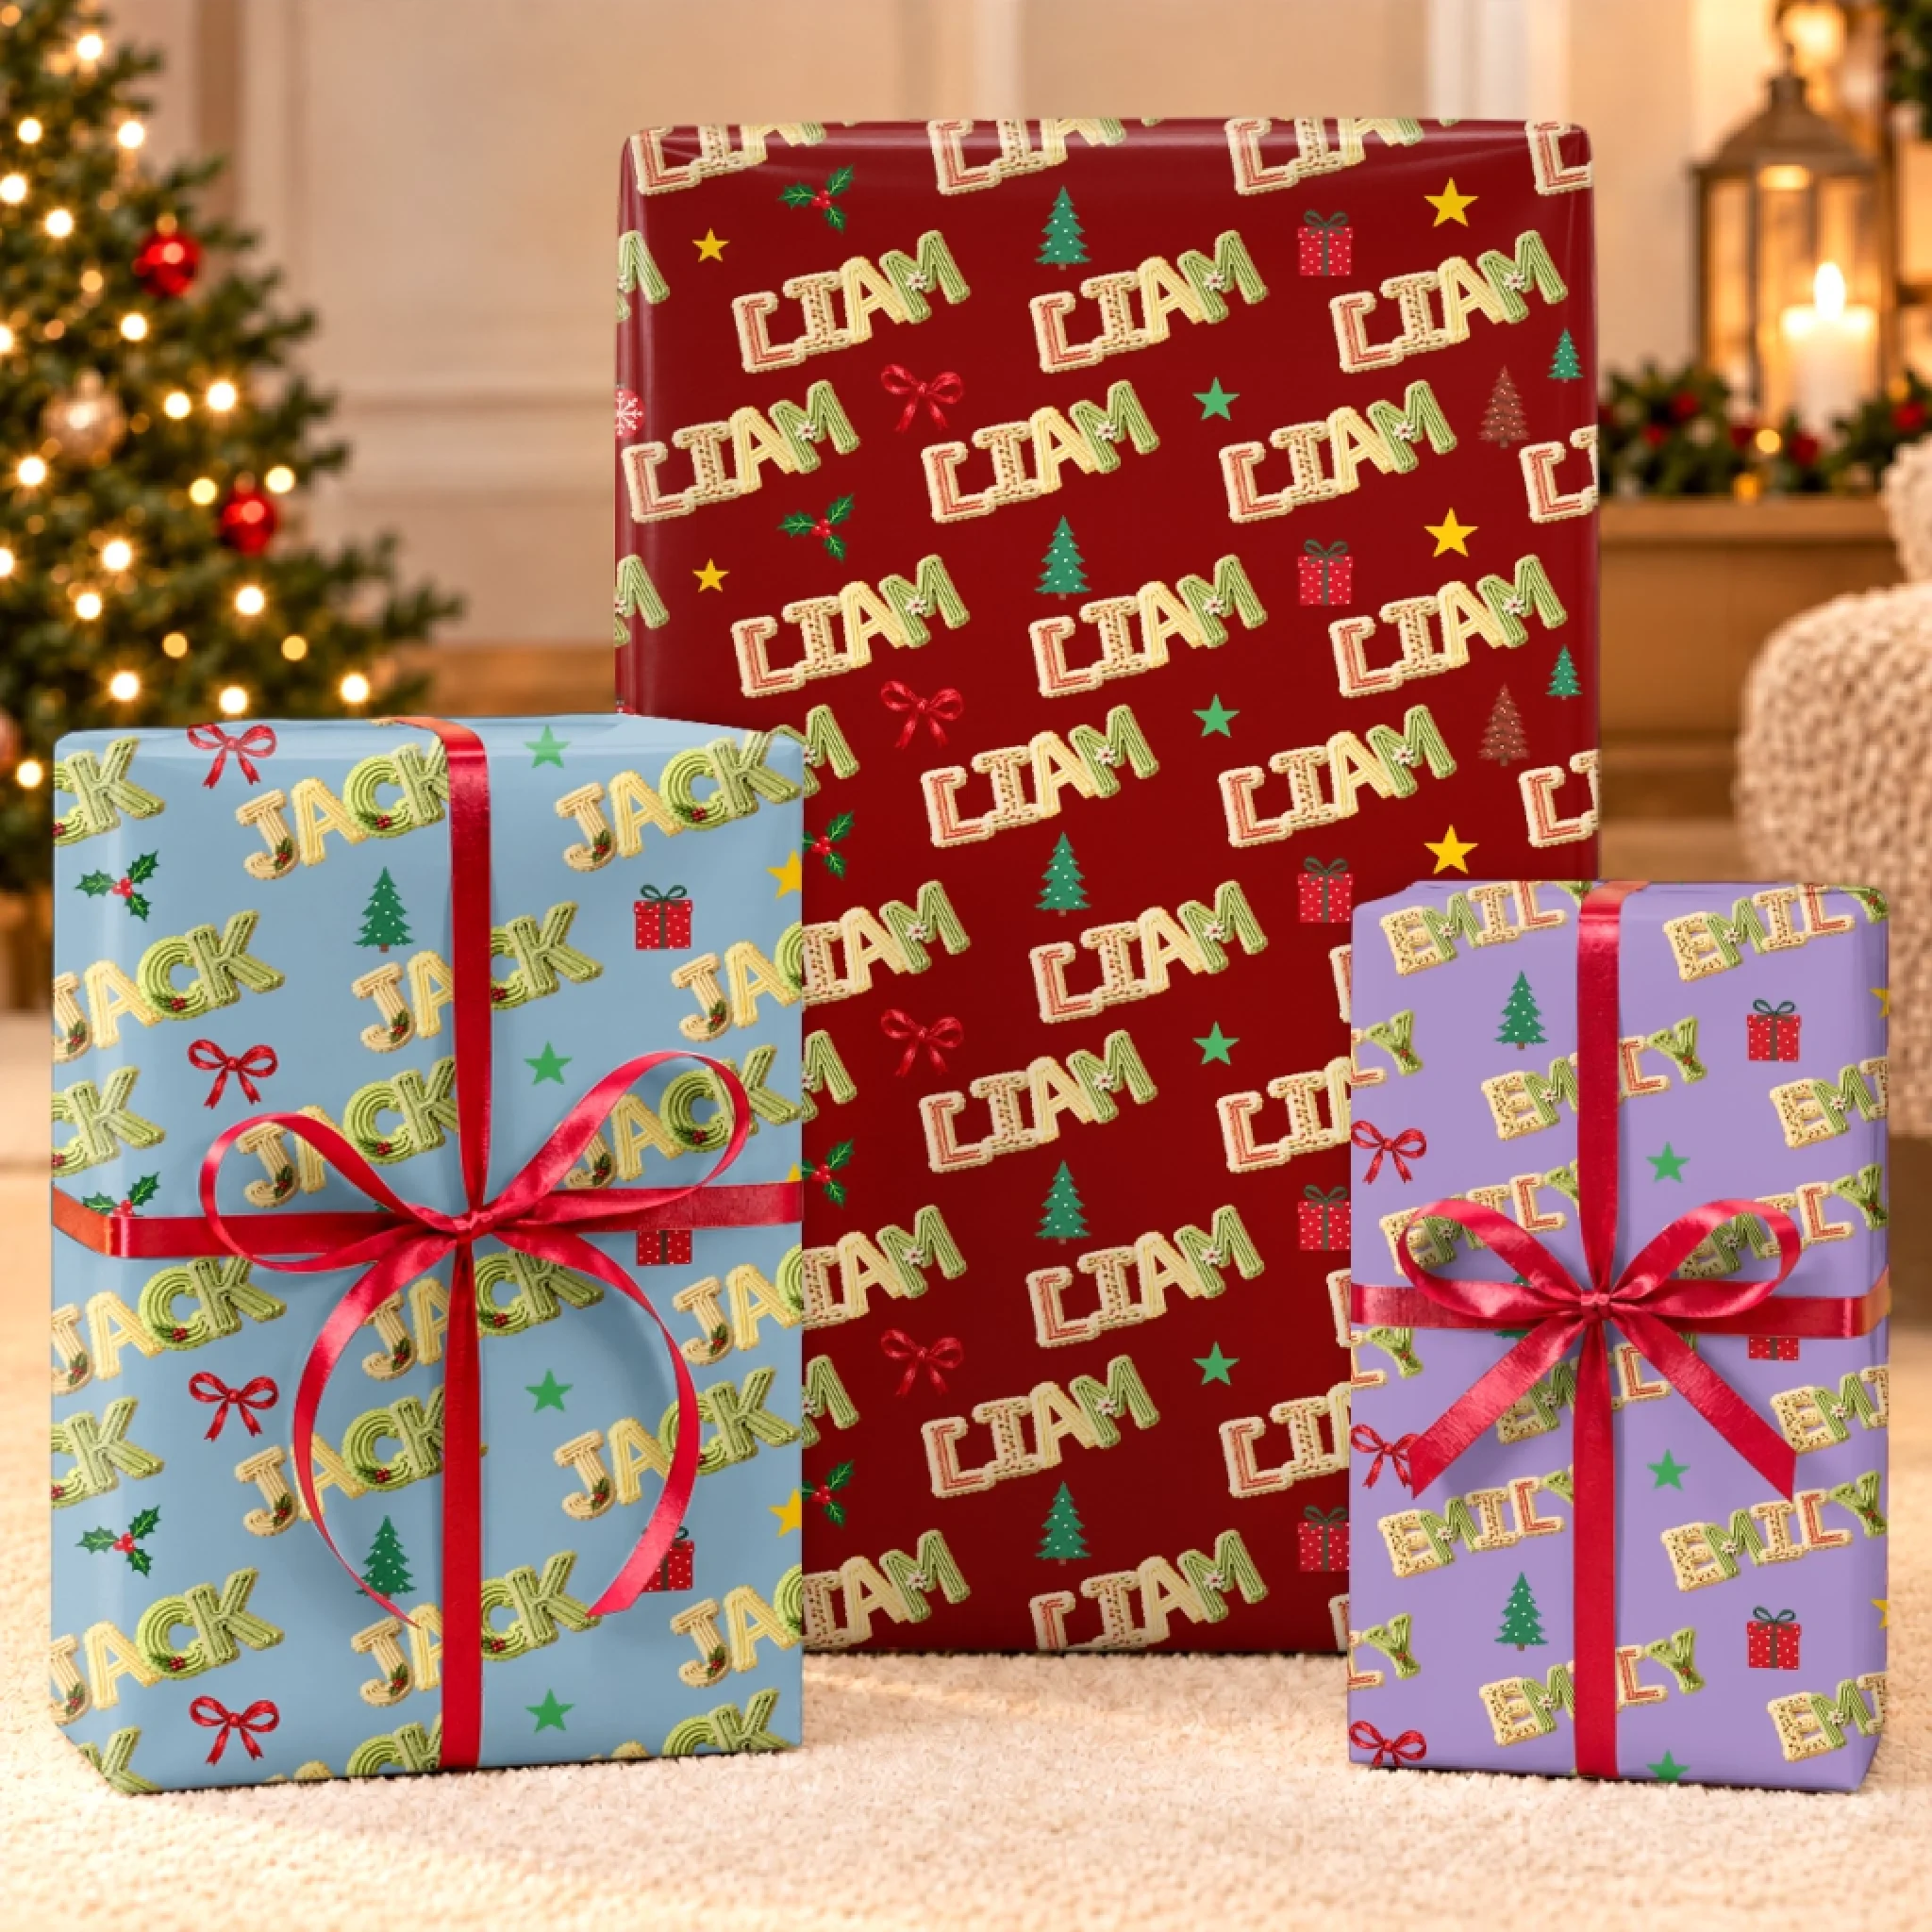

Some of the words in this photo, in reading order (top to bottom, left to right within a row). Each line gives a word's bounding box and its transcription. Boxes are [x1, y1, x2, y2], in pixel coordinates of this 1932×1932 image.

[731, 230, 970, 373] LIAM
[1030, 230, 1268, 373] LIAM
[1329, 230, 1568, 373] LIAM
[622, 380, 860, 523] LIAM
[922, 380, 1159, 523] LIAM
[1219, 380, 1457, 523] LIAM
[730, 554, 970, 698] LIAM
[1028, 554, 1267, 698] LIAM
[1328, 554, 1567, 698] LIAM
[555, 731, 802, 872] JACK
[921, 705, 1158, 847] LIAM
[1219, 705, 1457, 847] LIAM
[802, 880, 970, 1009] IAM
[1029, 880, 1268, 1024] LIAM
[919, 1029, 1158, 1173] LIAM
[1481, 1015, 1707, 1141] EMLY
[802, 1205, 967, 1329] IAM
[1026, 1205, 1264, 1348] LIAM
[921, 1354, 1160, 1498] LIAM
[802, 1529, 970, 1650] IAM
[1660, 1470, 1887, 1591] EMILY
[1479, 1627, 1705, 1746] EMLY
